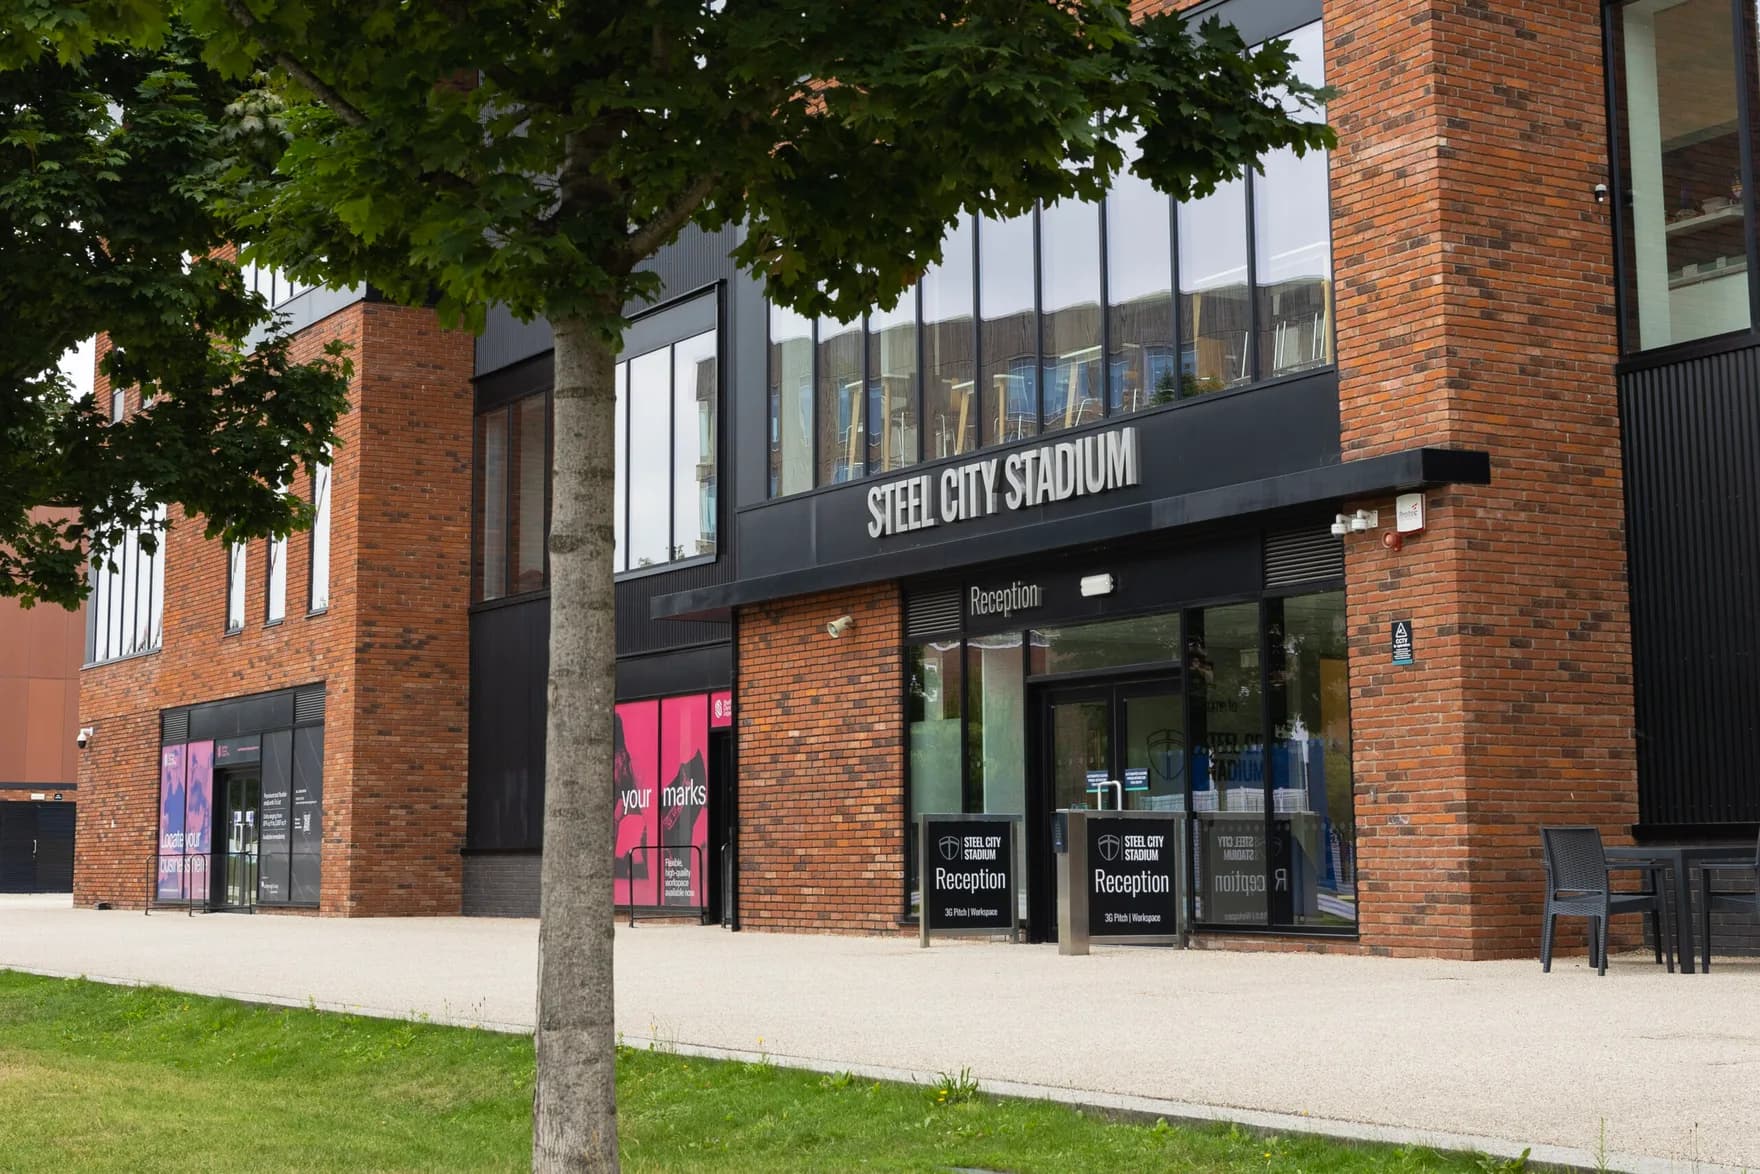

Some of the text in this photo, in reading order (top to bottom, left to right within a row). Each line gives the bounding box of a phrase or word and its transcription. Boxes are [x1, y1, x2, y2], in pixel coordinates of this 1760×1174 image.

[867, 426, 1140, 538] STEEL CITY STADIUM
[970, 580, 1039, 618] Reception
[621, 777, 707, 816] your marks
[160, 829, 184, 849] Locate
[963, 835, 1001, 849] STEEL CITY
[1124, 835, 1164, 848] STEEL CITY
[963, 848, 996, 861] STADIUM
[1124, 848, 1159, 861] STADIUM
[935, 867, 1007, 895] Reception
[1095, 868, 1169, 898] Reception
[944, 907, 953, 917] 3G
[953, 907, 967, 917] Pitch
[970, 907, 998, 918] Workspace
[1104, 912, 1113, 923] 3G
[1114, 912, 1128, 923] Pitch
[1132, 912, 1161, 924] Workspace
